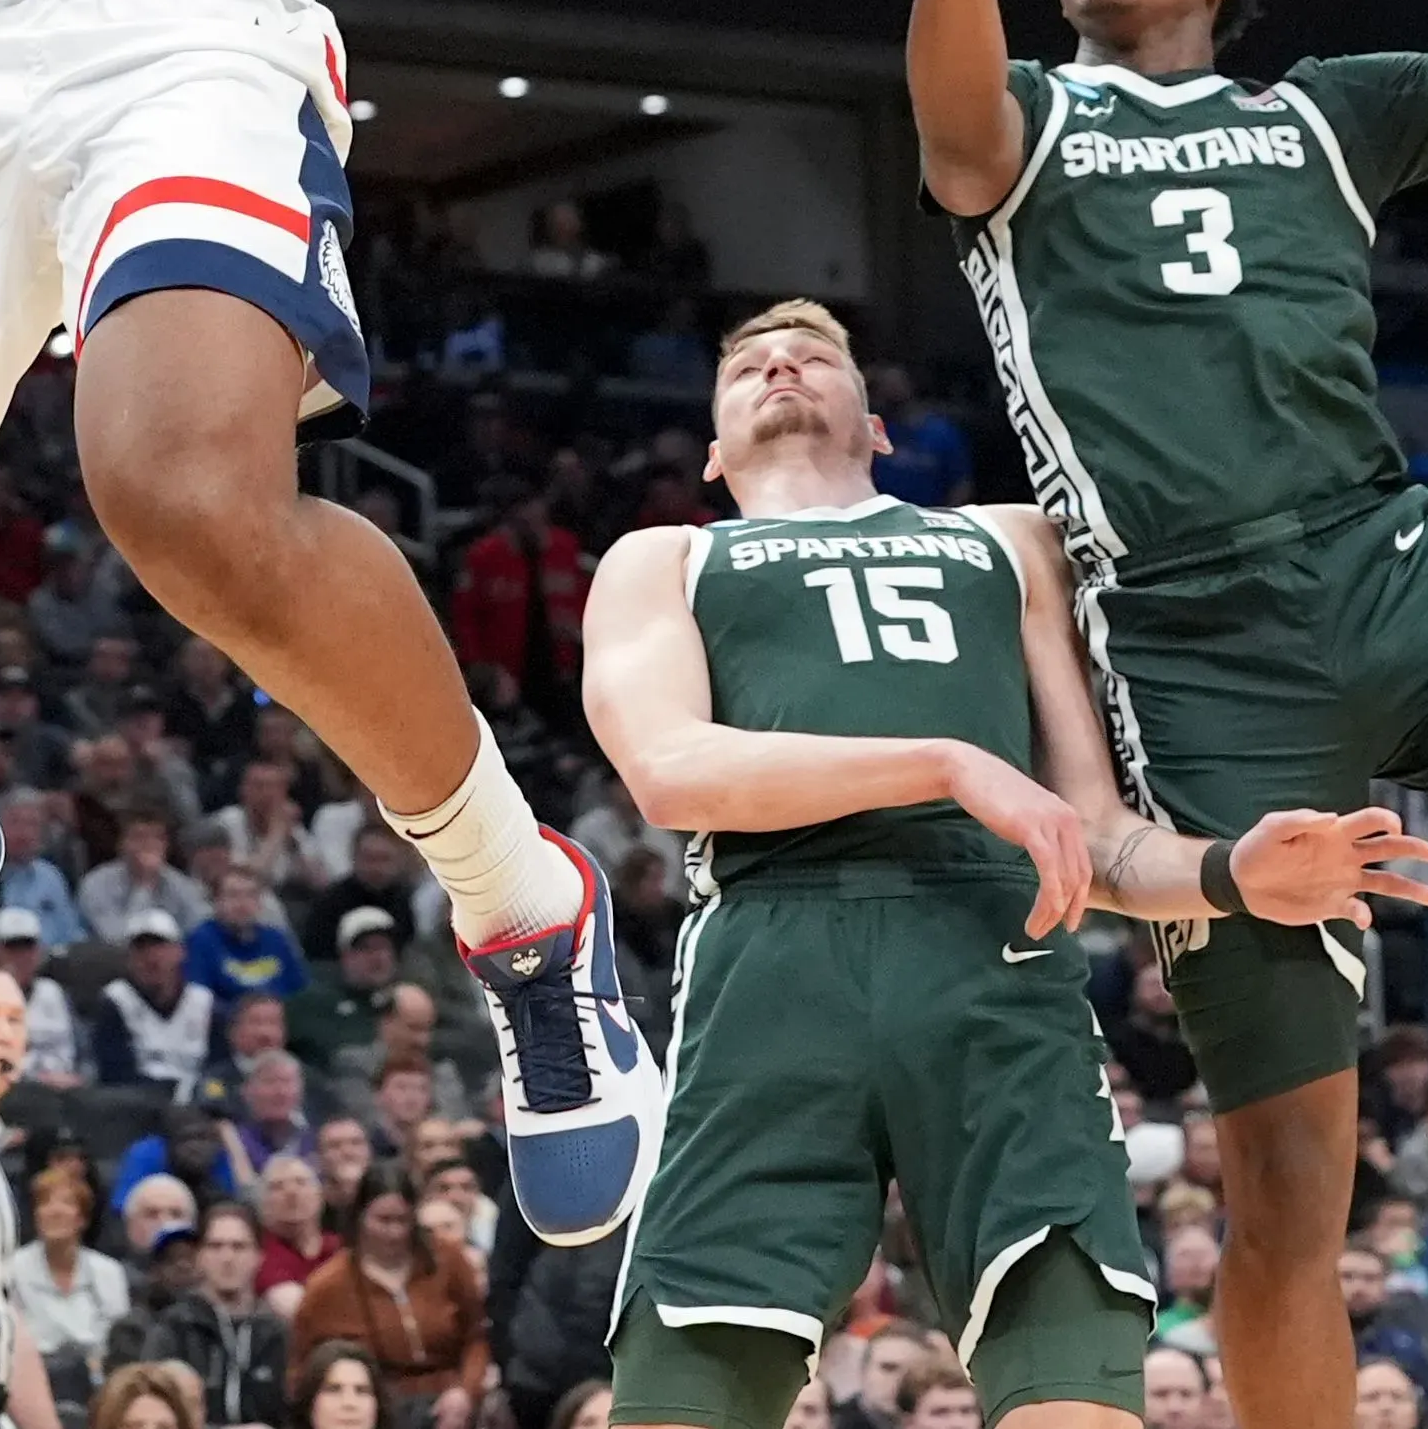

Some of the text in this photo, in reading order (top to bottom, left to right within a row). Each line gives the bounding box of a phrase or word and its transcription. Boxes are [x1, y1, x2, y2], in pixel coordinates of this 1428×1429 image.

[1060, 124, 1305, 178] SPARTANS
[1150, 187, 1243, 296] 3
[728, 532, 994, 571] SPARTANS
[803, 565, 959, 664] 15
